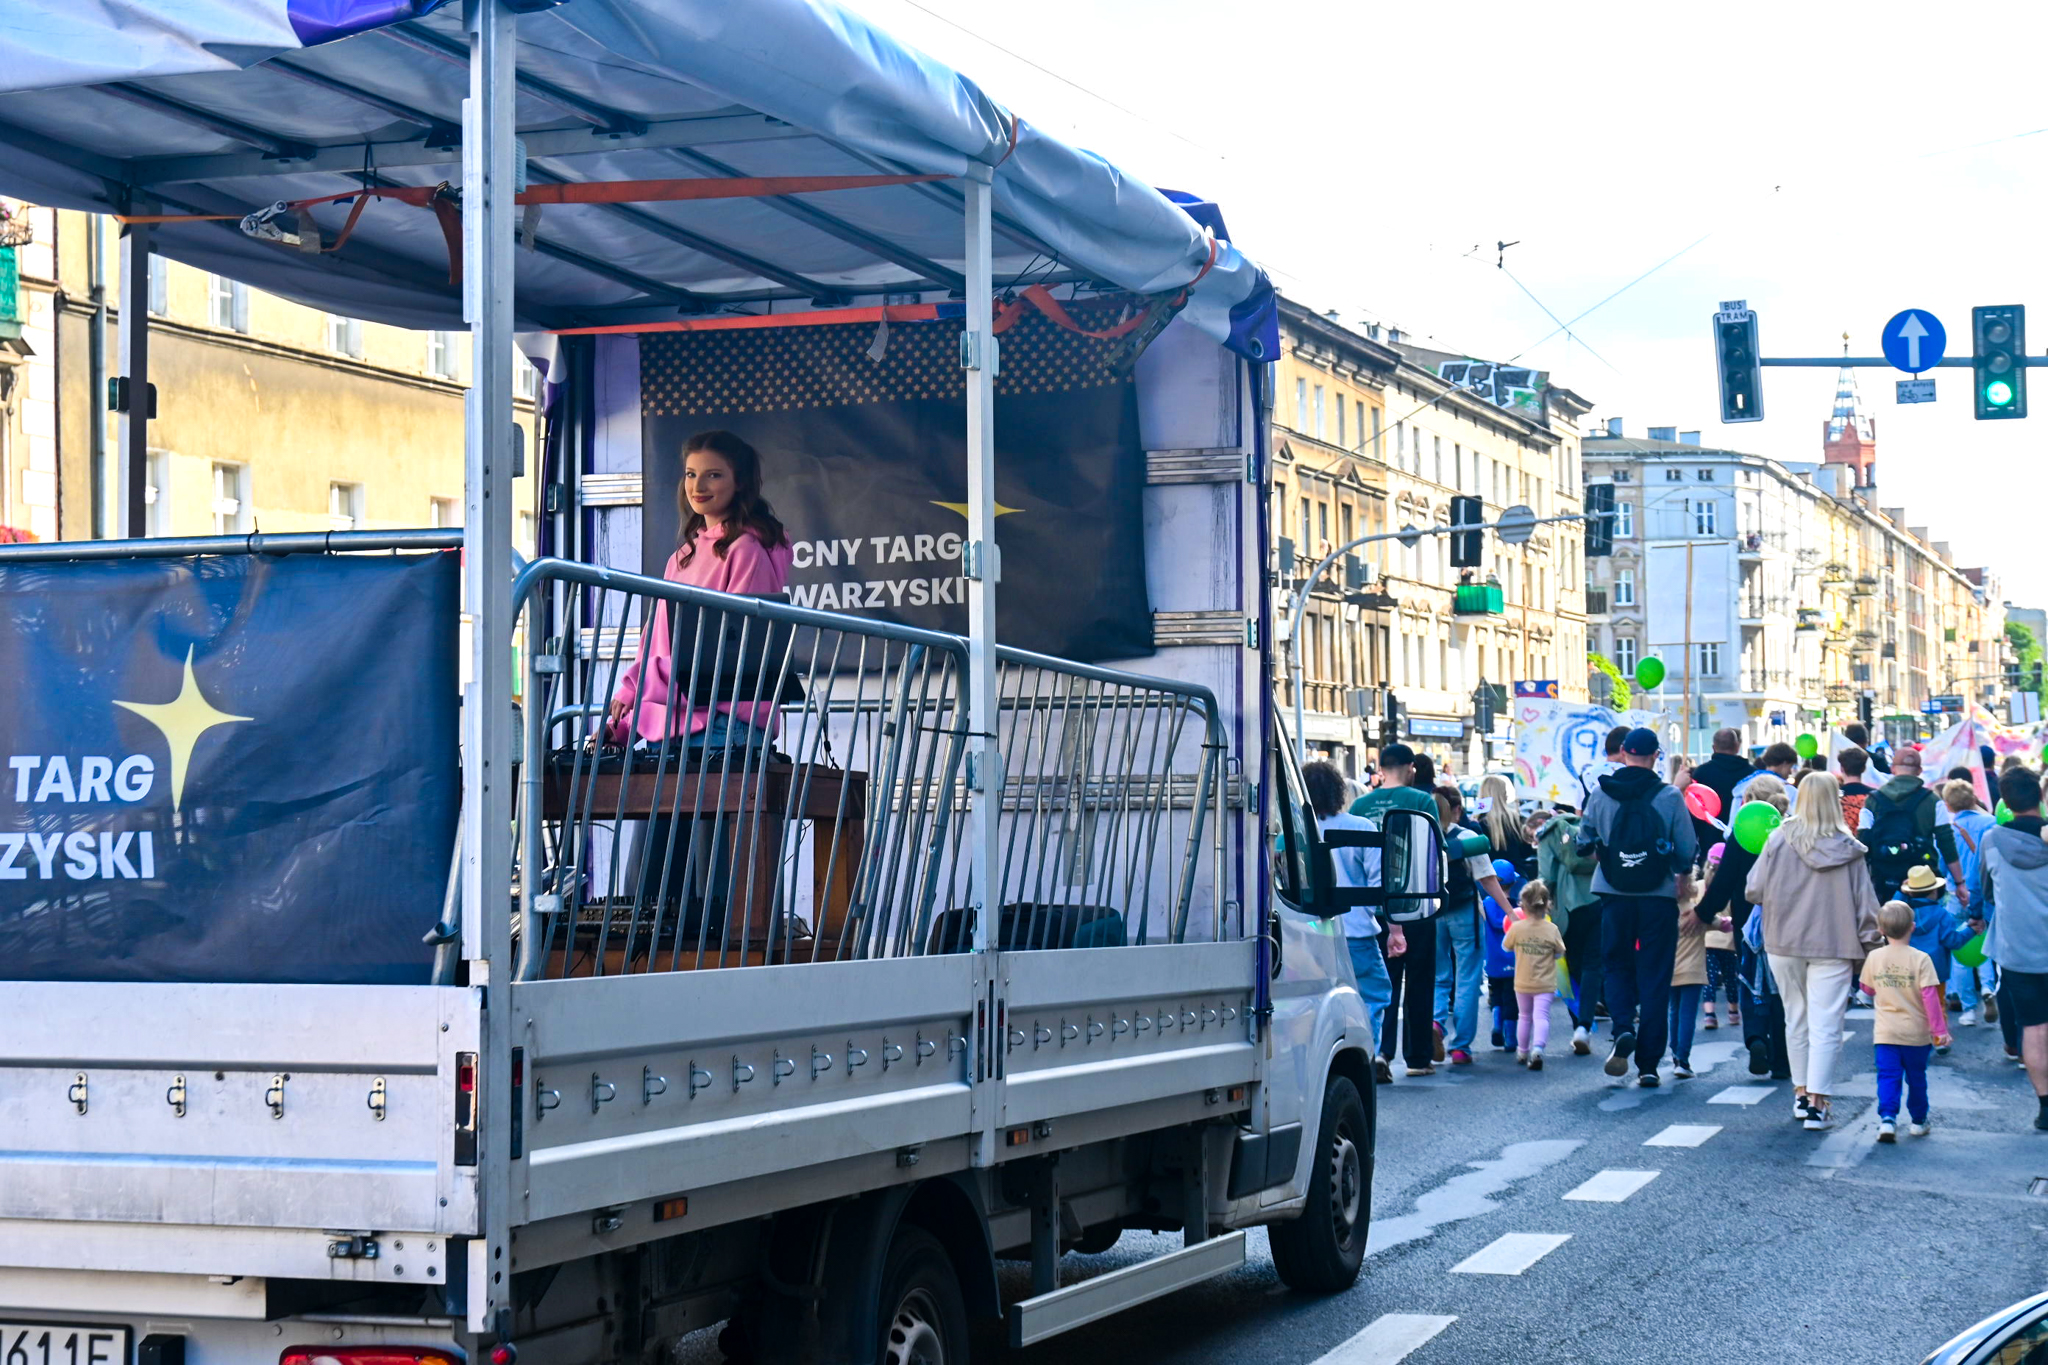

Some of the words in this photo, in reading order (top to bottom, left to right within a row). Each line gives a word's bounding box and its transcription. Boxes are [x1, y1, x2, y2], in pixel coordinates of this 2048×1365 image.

[1724, 301, 1742, 310] BUS
[1721, 312, 1748, 321] TRAM
[870, 532, 962, 564] TARG
[9, 754, 155, 803] TARG
[0, 831, 155, 880] ZYSKI
[1619, 851, 1648, 859] Reebok
